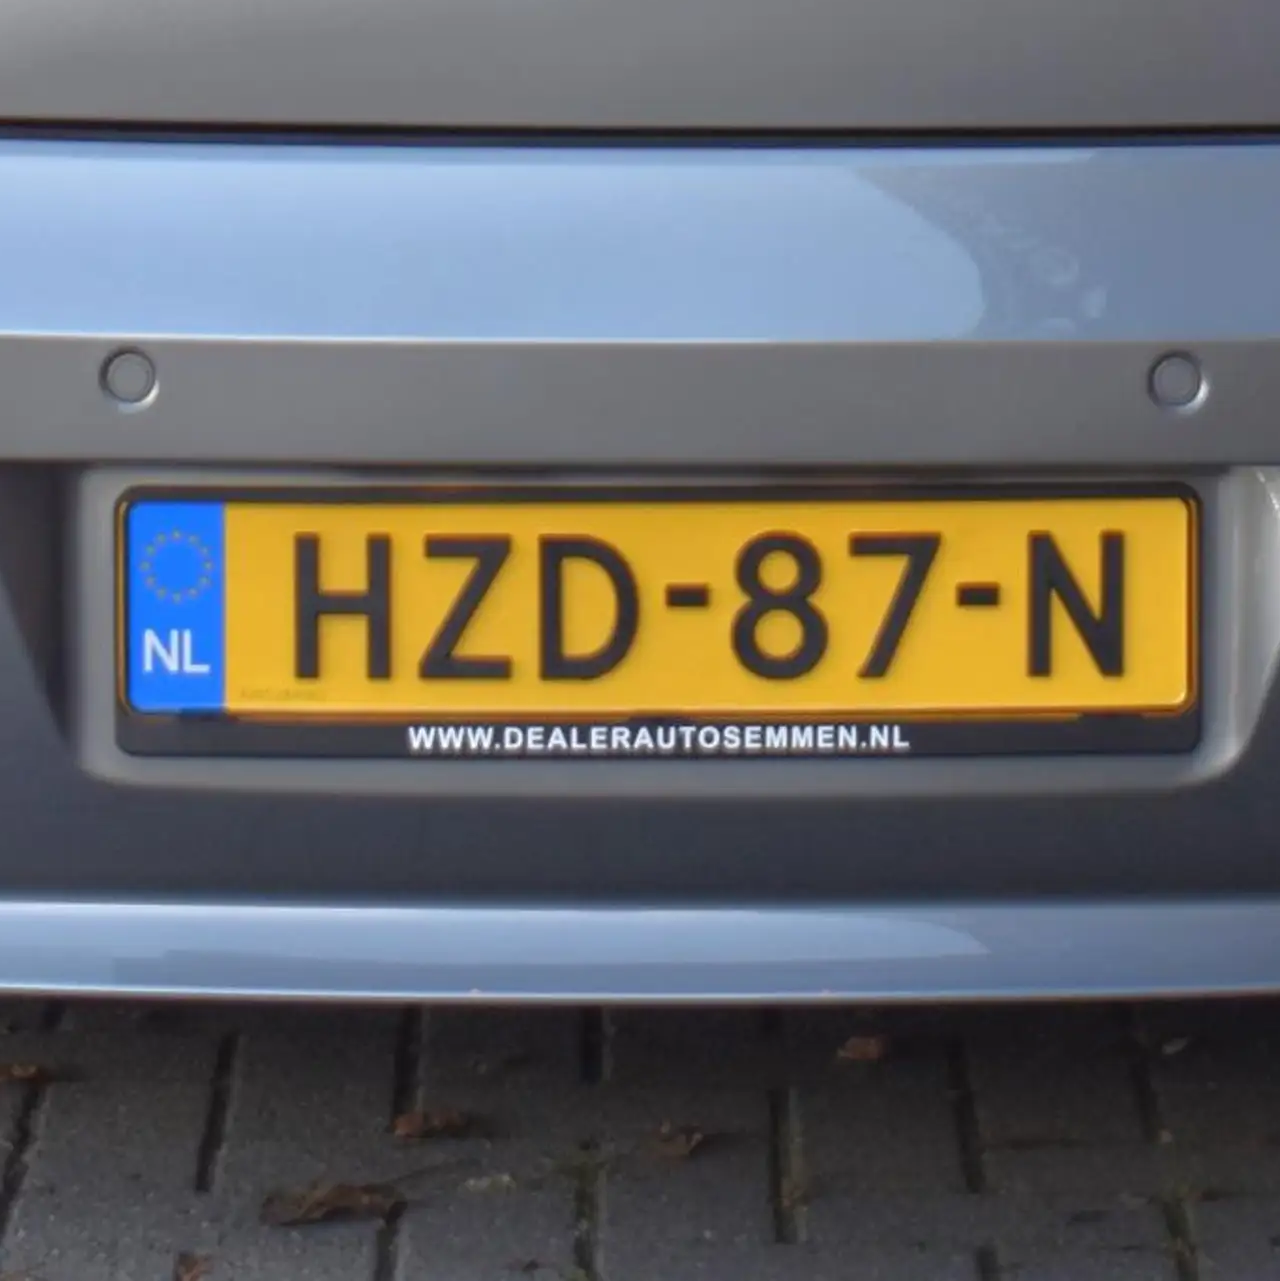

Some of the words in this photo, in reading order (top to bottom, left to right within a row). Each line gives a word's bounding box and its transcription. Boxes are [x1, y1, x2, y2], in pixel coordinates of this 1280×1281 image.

[292, 529, 1127, 683] HZD-87-N
[143, 628, 210, 674] NL
[407, 725, 910, 751] WWW.DEALERAUTOSEMMEN.NL
